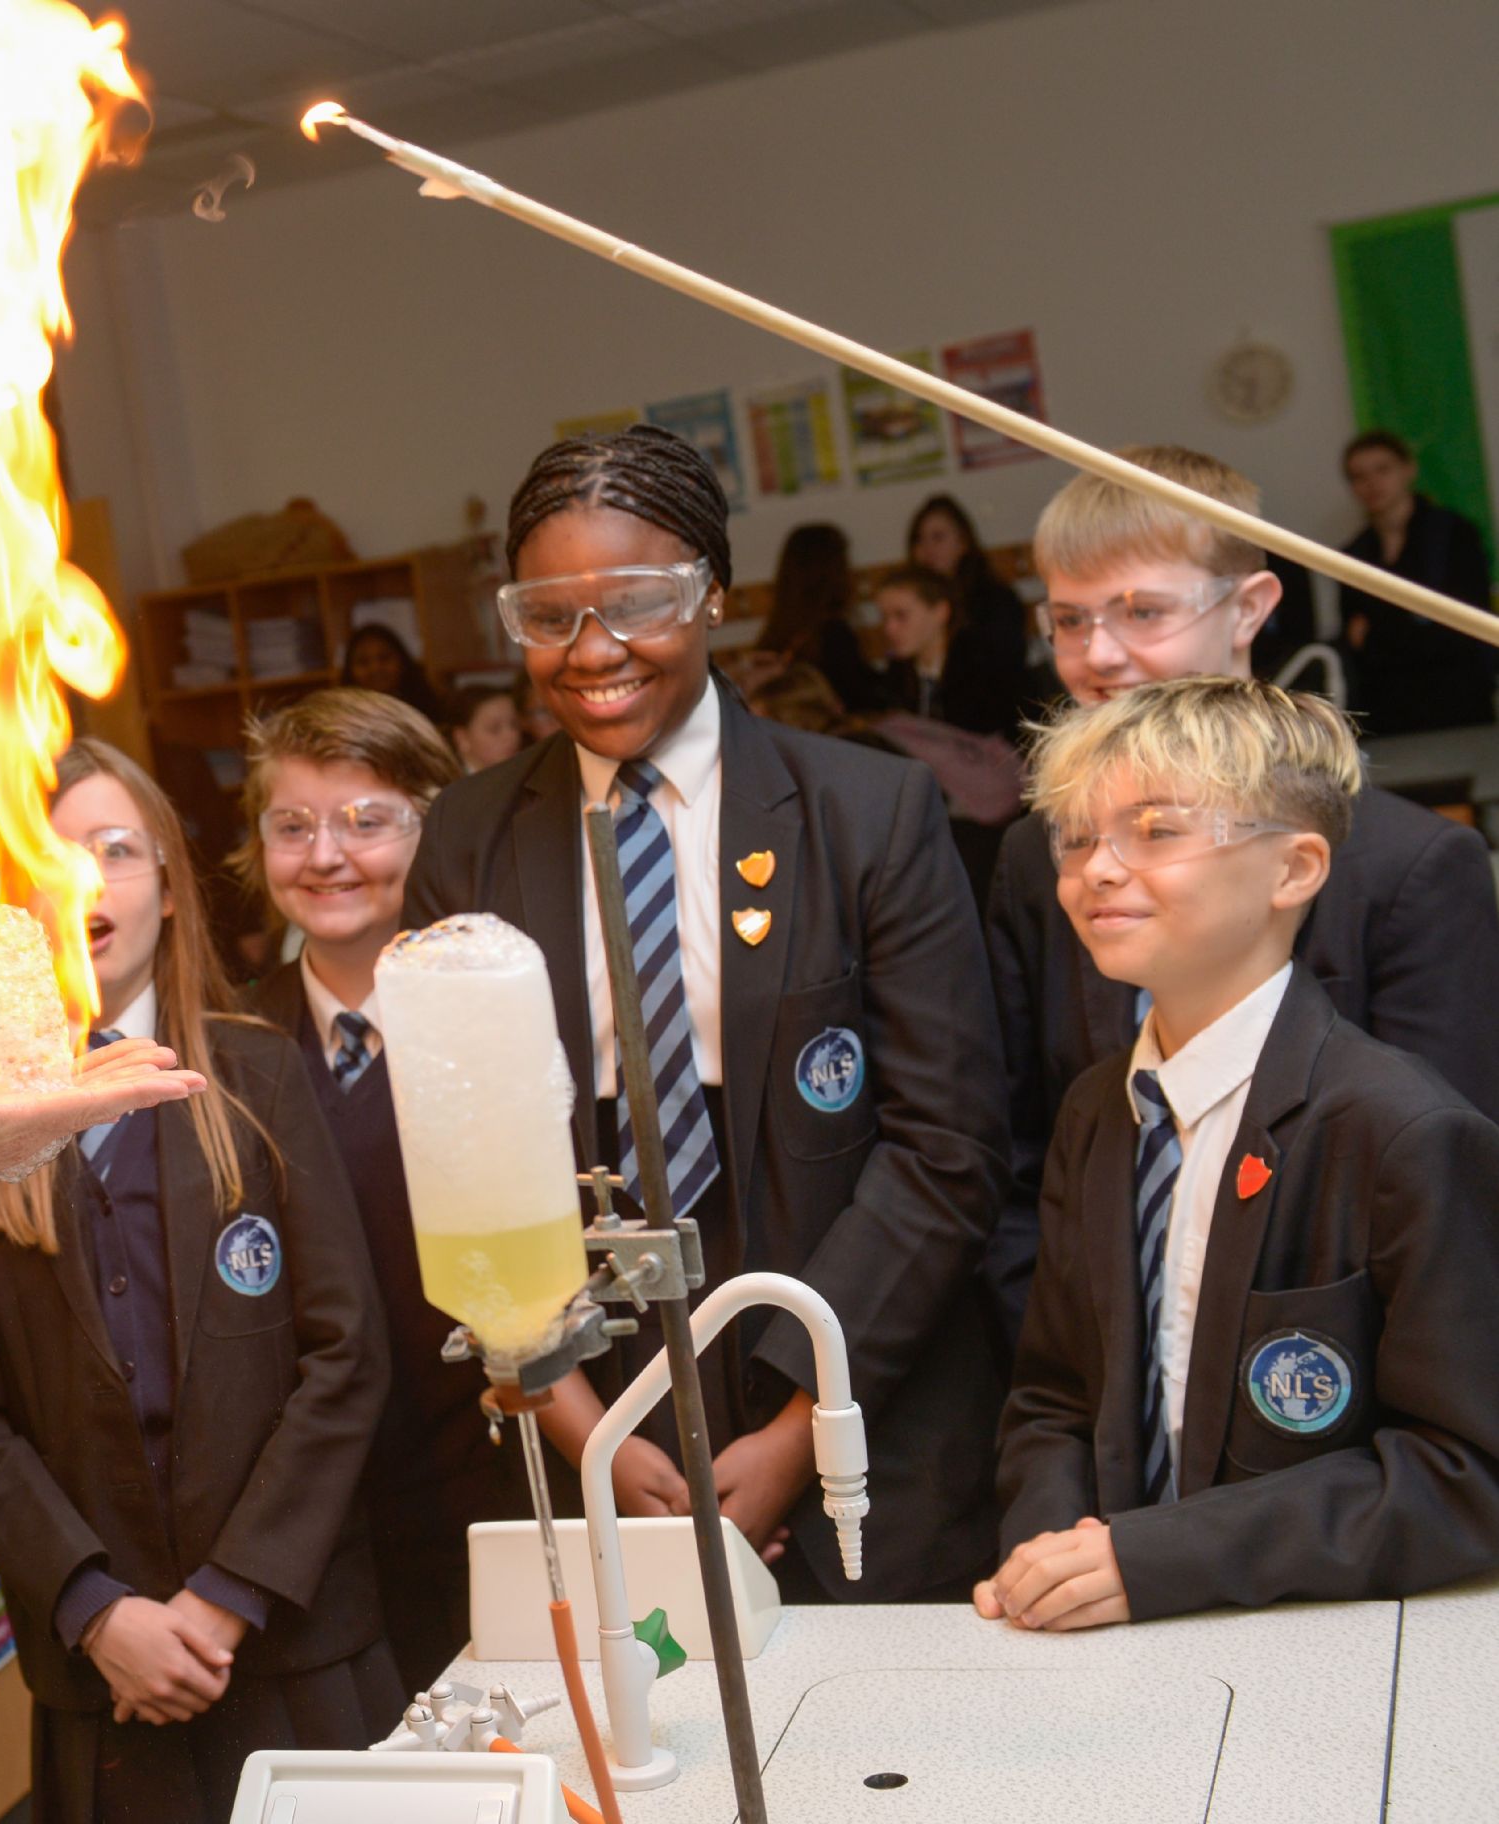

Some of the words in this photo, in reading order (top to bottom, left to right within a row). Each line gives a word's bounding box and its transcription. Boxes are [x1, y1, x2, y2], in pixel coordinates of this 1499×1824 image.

[811, 1053, 855, 1087] NLS
[229, 1242, 273, 1271] NLS
[1269, 1372, 1334, 1401] NLS
